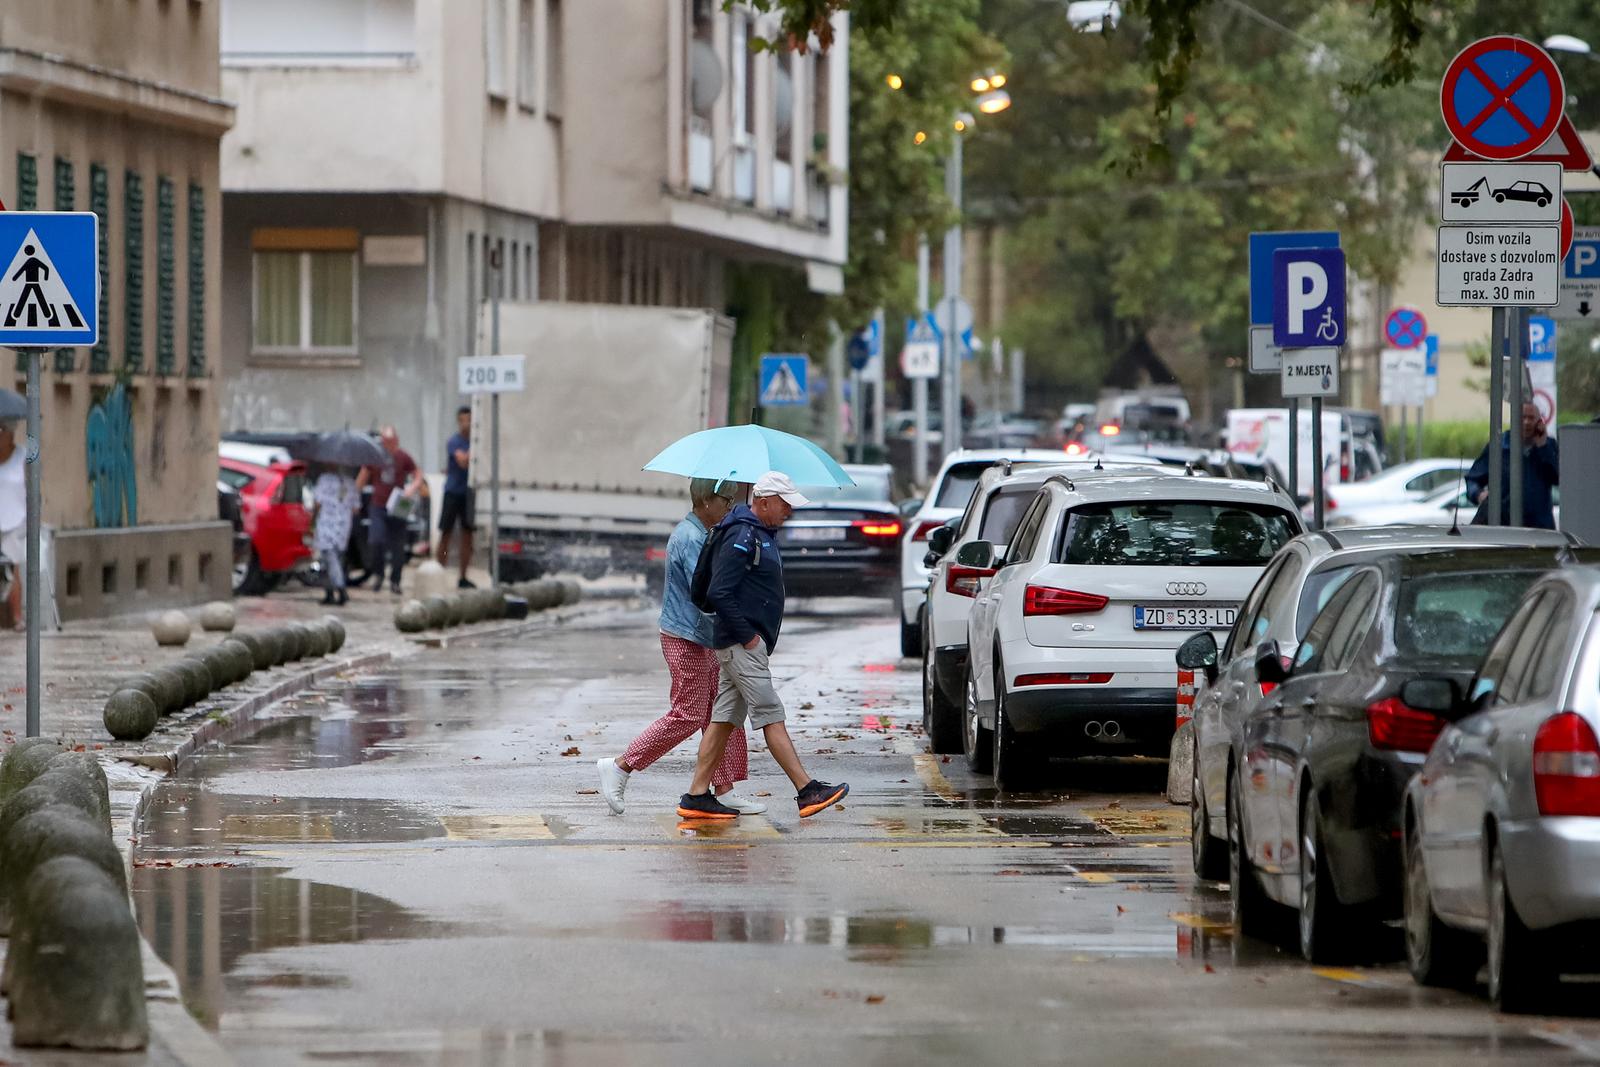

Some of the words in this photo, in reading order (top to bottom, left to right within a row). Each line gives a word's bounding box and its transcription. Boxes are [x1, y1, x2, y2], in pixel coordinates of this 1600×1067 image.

[1466, 231, 1494, 245] Osim
[1498, 231, 1531, 245] vozila
[1441, 249, 1487, 263] dostave
[1490, 253, 1497, 263] s
[1500, 250, 1556, 263] dozvolom
[1574, 245, 1597, 275] P
[1463, 268, 1496, 285] grada
[1500, 268, 1533, 281] Zadra
[1287, 261, 1328, 335] P
[1461, 289, 1488, 300] max.
[1493, 286, 1509, 300] 30
[1513, 286, 1535, 300] min
[1529, 323, 1545, 355] P
[465, 366, 497, 385] 200
[503, 369, 518, 384] m
[1287, 366, 1293, 376] 2
[1295, 365, 1332, 376] MJESTA
[1146, 609, 1165, 625] ZD
